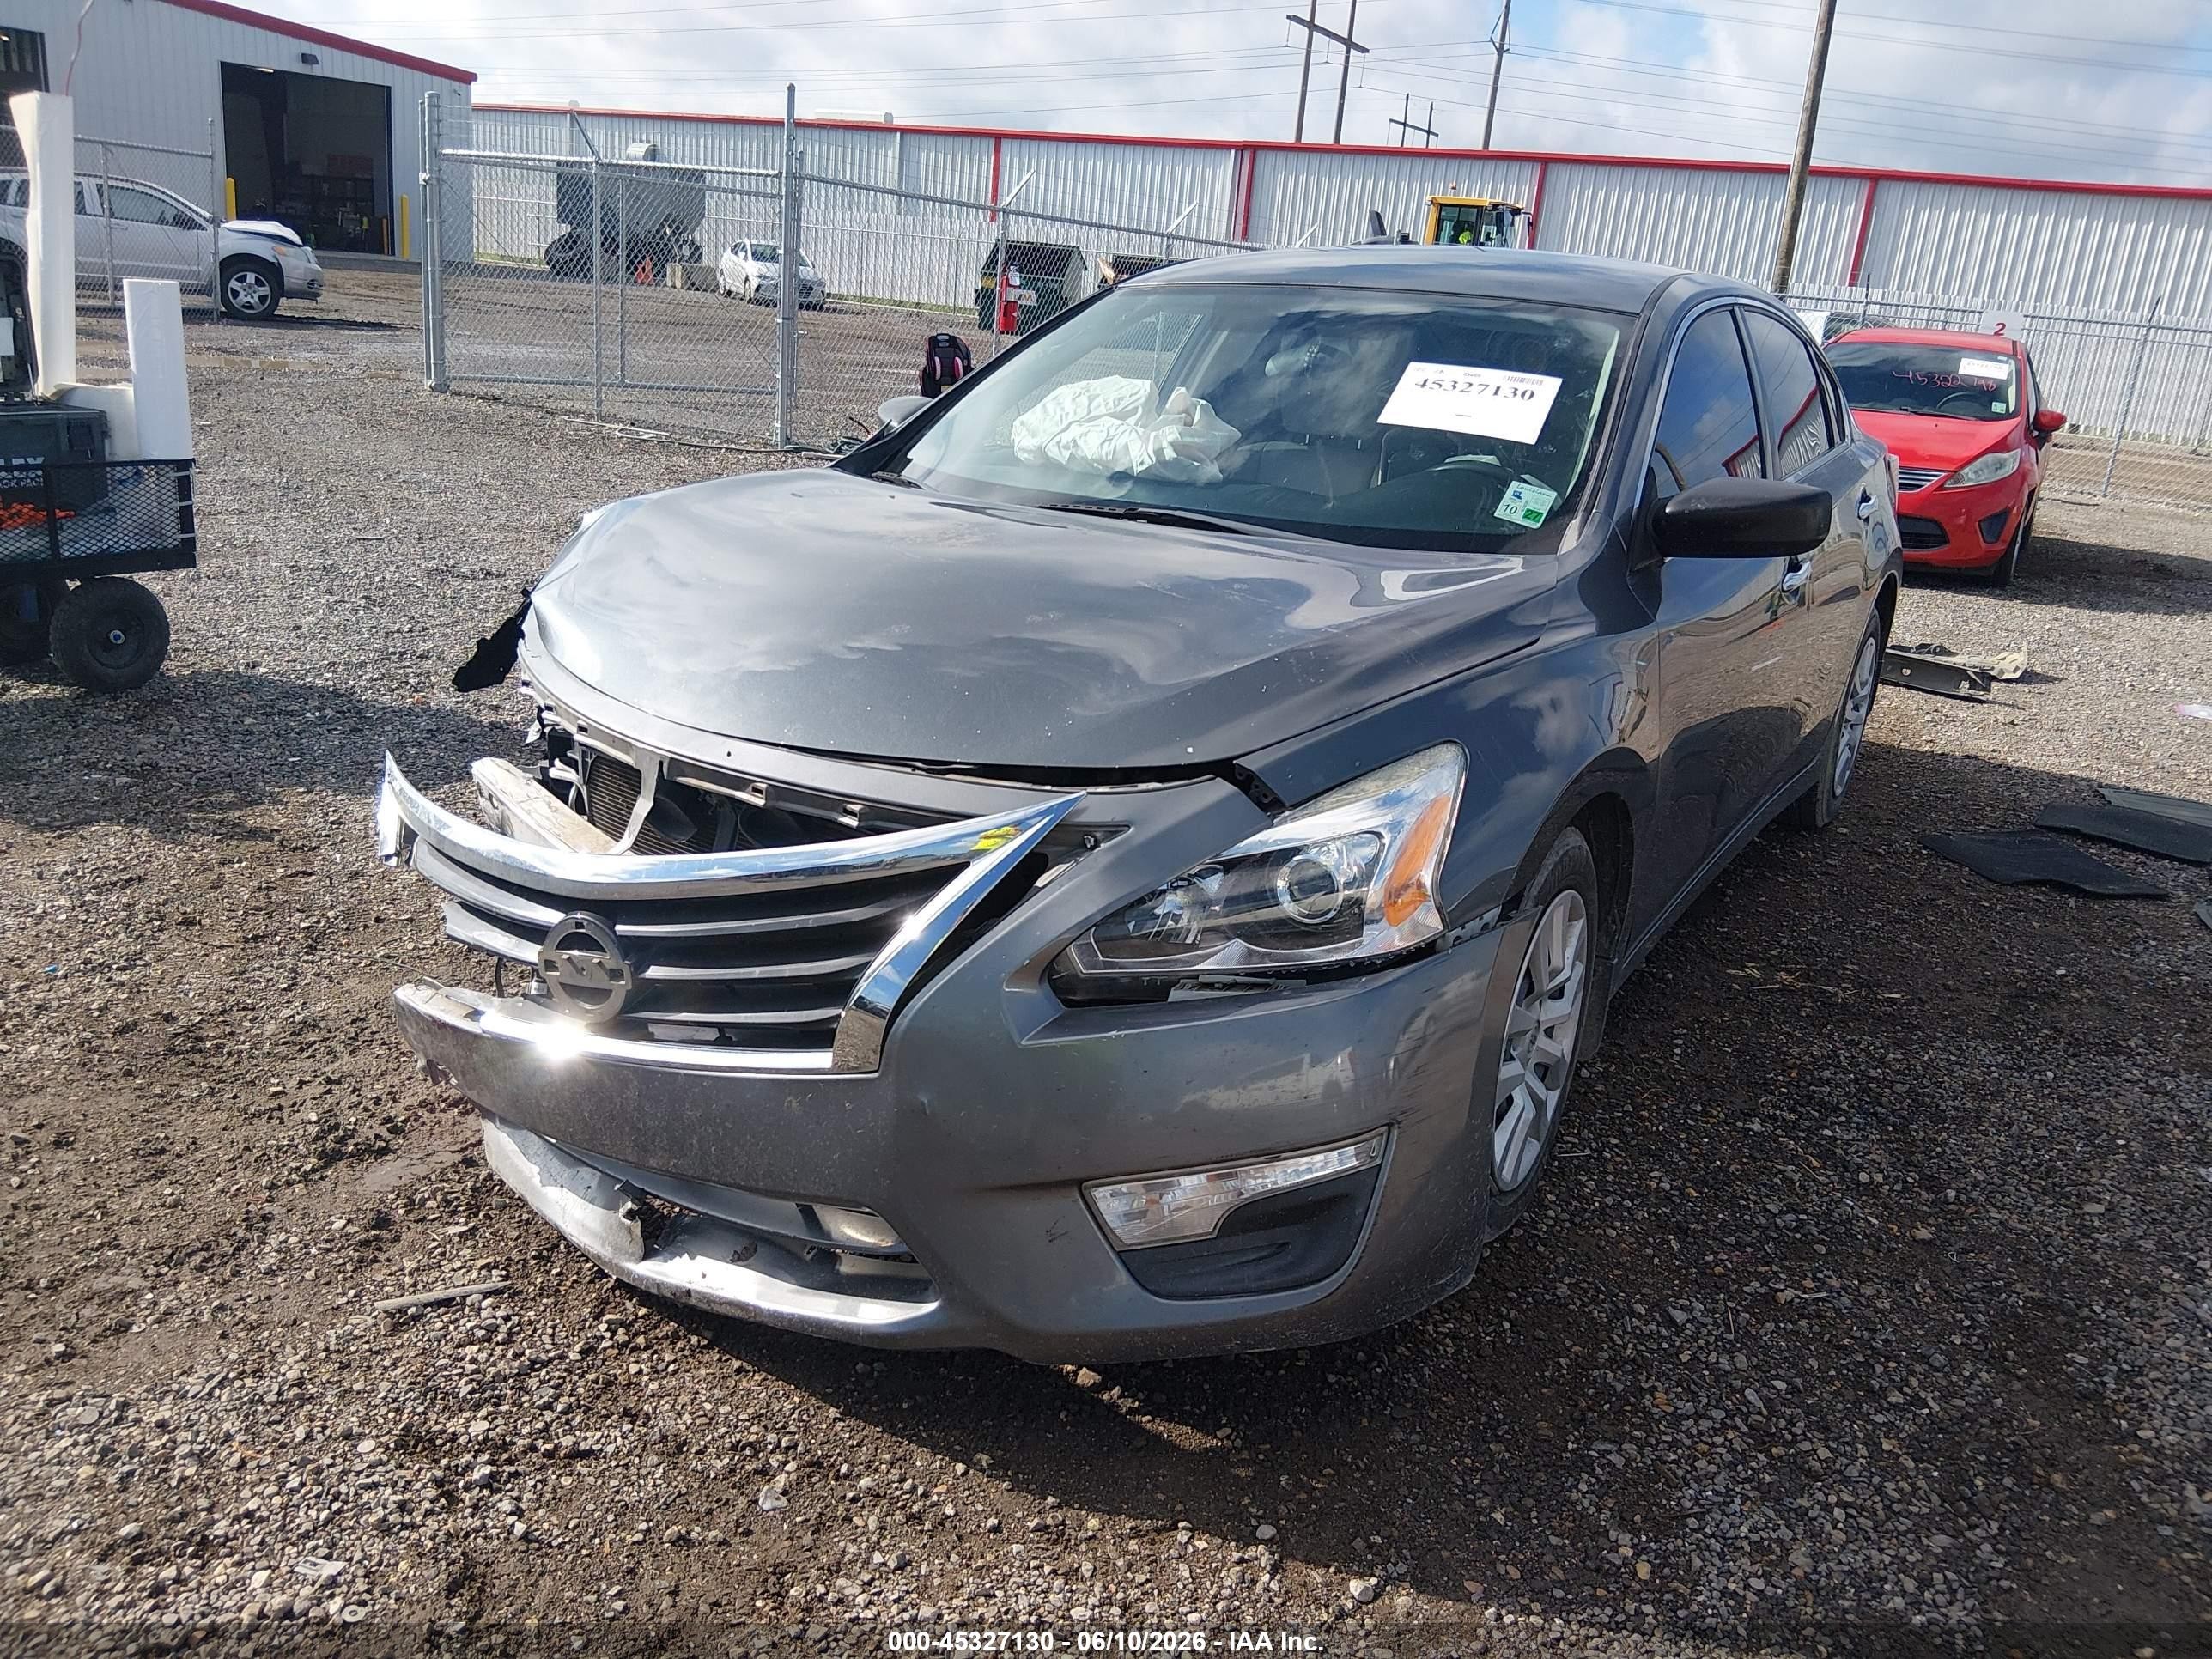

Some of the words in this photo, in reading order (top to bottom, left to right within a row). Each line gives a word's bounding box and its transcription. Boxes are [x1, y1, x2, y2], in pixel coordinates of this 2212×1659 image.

[1993, 322, 2006, 336] 2
[1414, 378, 1535, 402] 45327130
[1504, 504, 1518, 515] 10
[1524, 509, 1542, 521] 27
